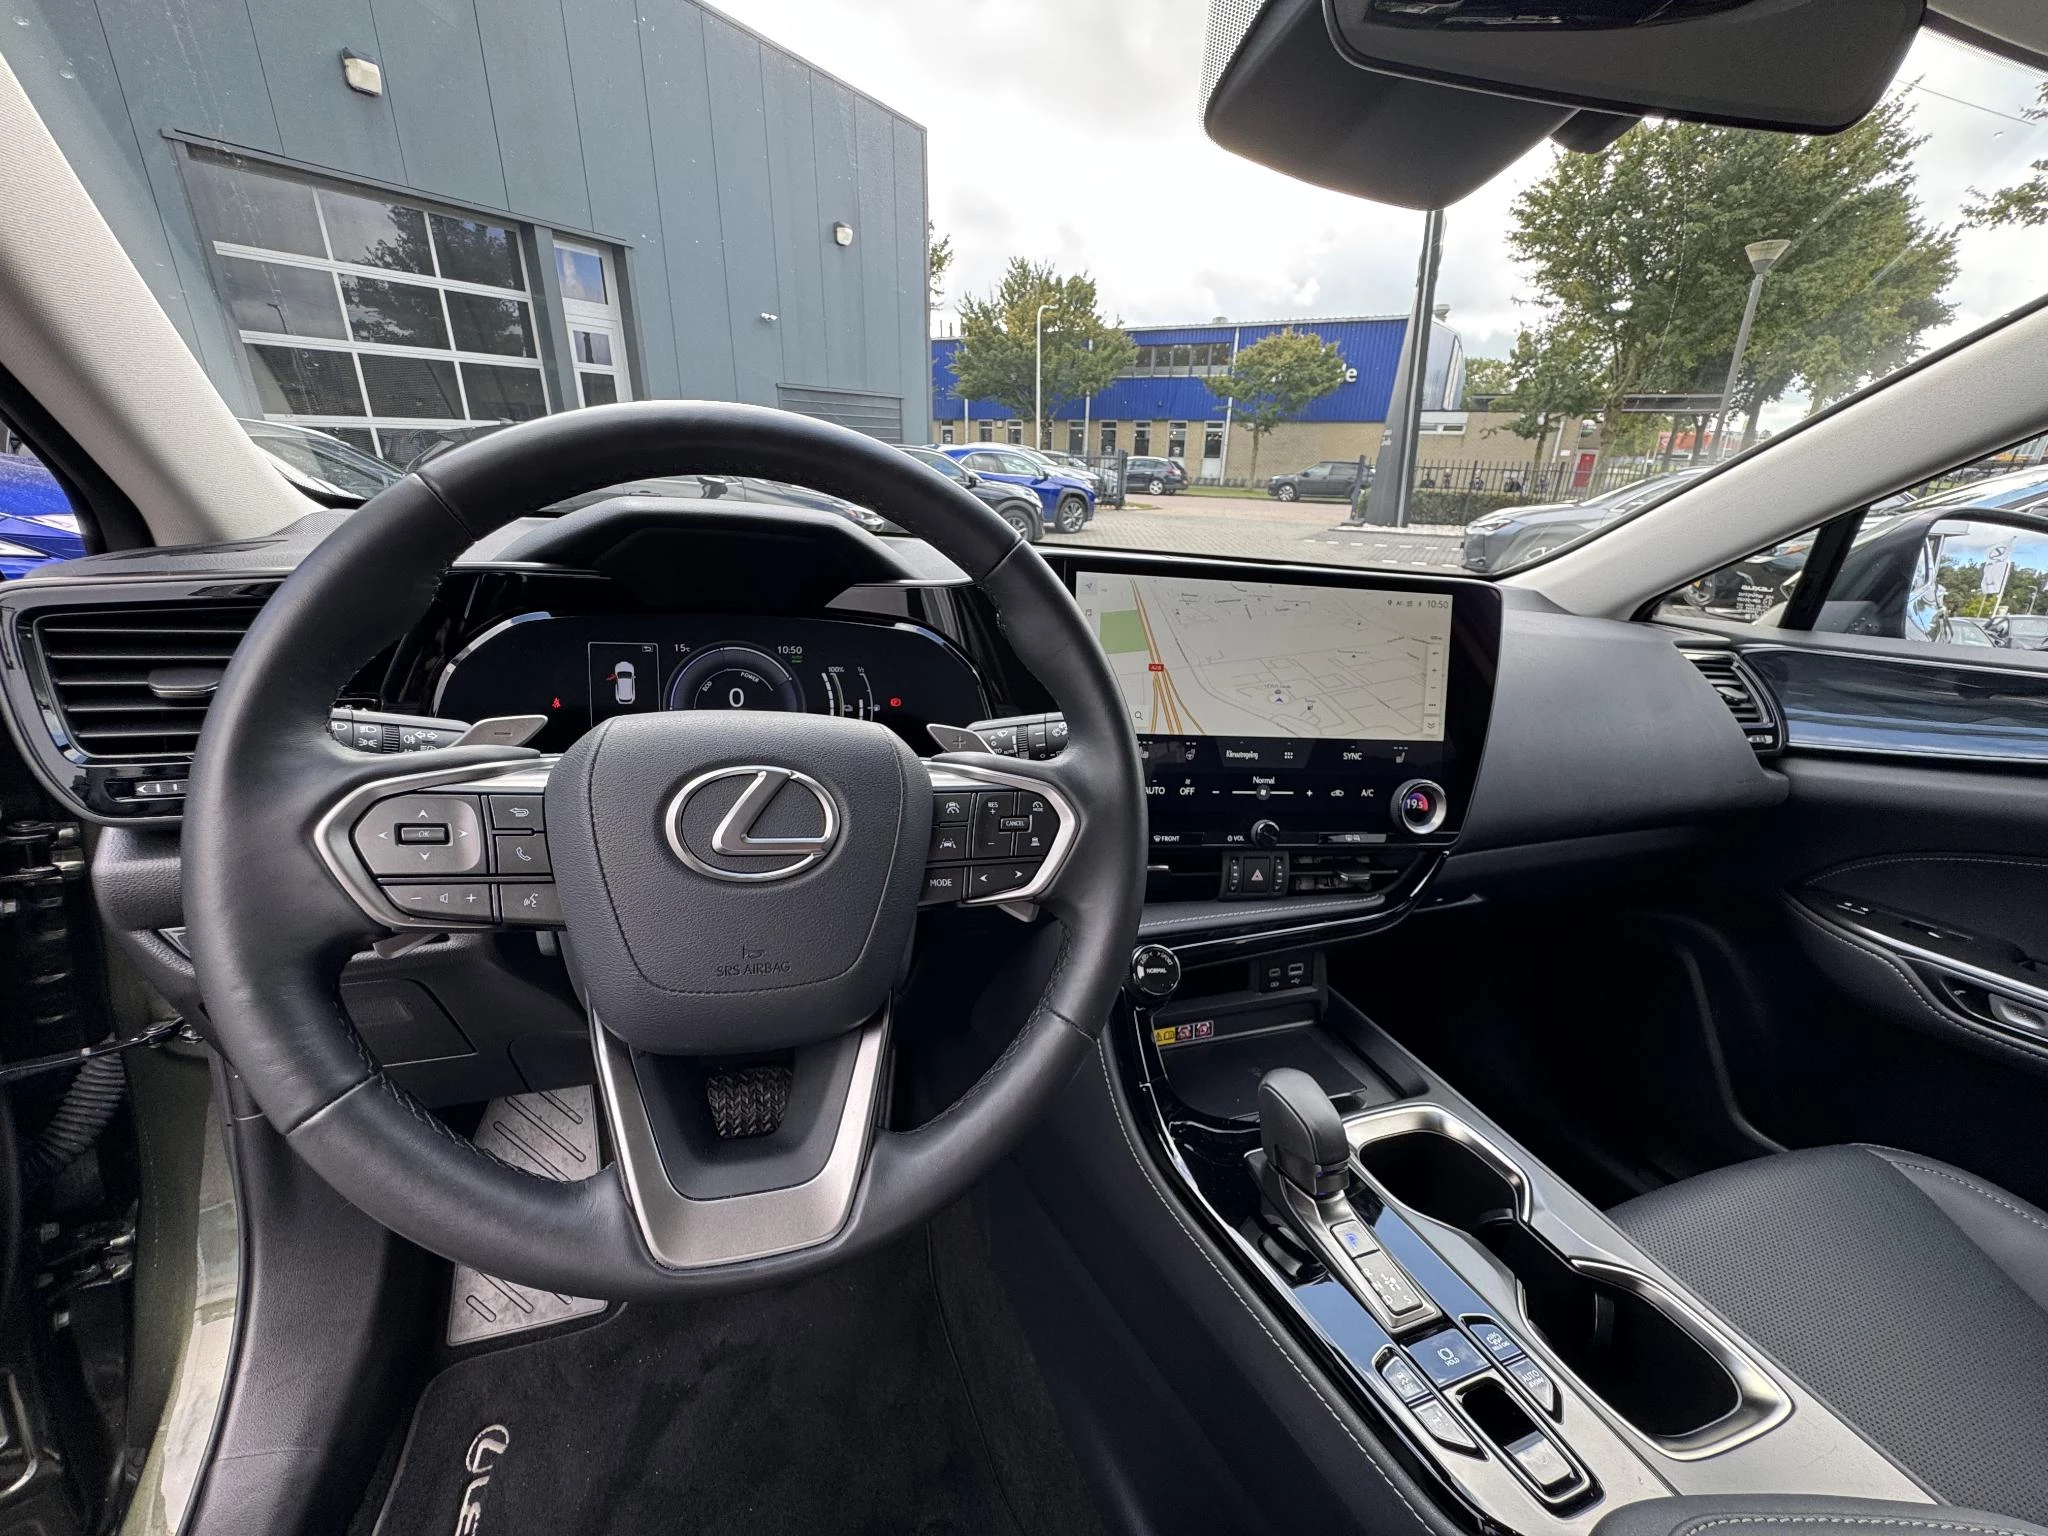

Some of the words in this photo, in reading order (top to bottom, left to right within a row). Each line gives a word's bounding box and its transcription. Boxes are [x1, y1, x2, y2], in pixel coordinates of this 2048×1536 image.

[1427, 599, 1449, 609] 10:50
[777, 645, 803, 655] 10:50
[740, 671, 760, 683] POWER
[702, 680, 713, 692] ECO
[729, 687, 744, 708] 0
[1343, 752, 1363, 761] SYNC
[1252, 776, 1276, 785] Normal
[1179, 787, 1196, 796] OFF
[1360, 789, 1375, 798] A/C
[1406, 799, 1424, 809] 19.5
[418, 830, 430, 838] OK
[929, 878, 953, 887] MODE
[716, 963, 740, 977] SRS
[743, 961, 791, 976] AIRBAG
[1521, 1369, 1540, 1383] AUTO
